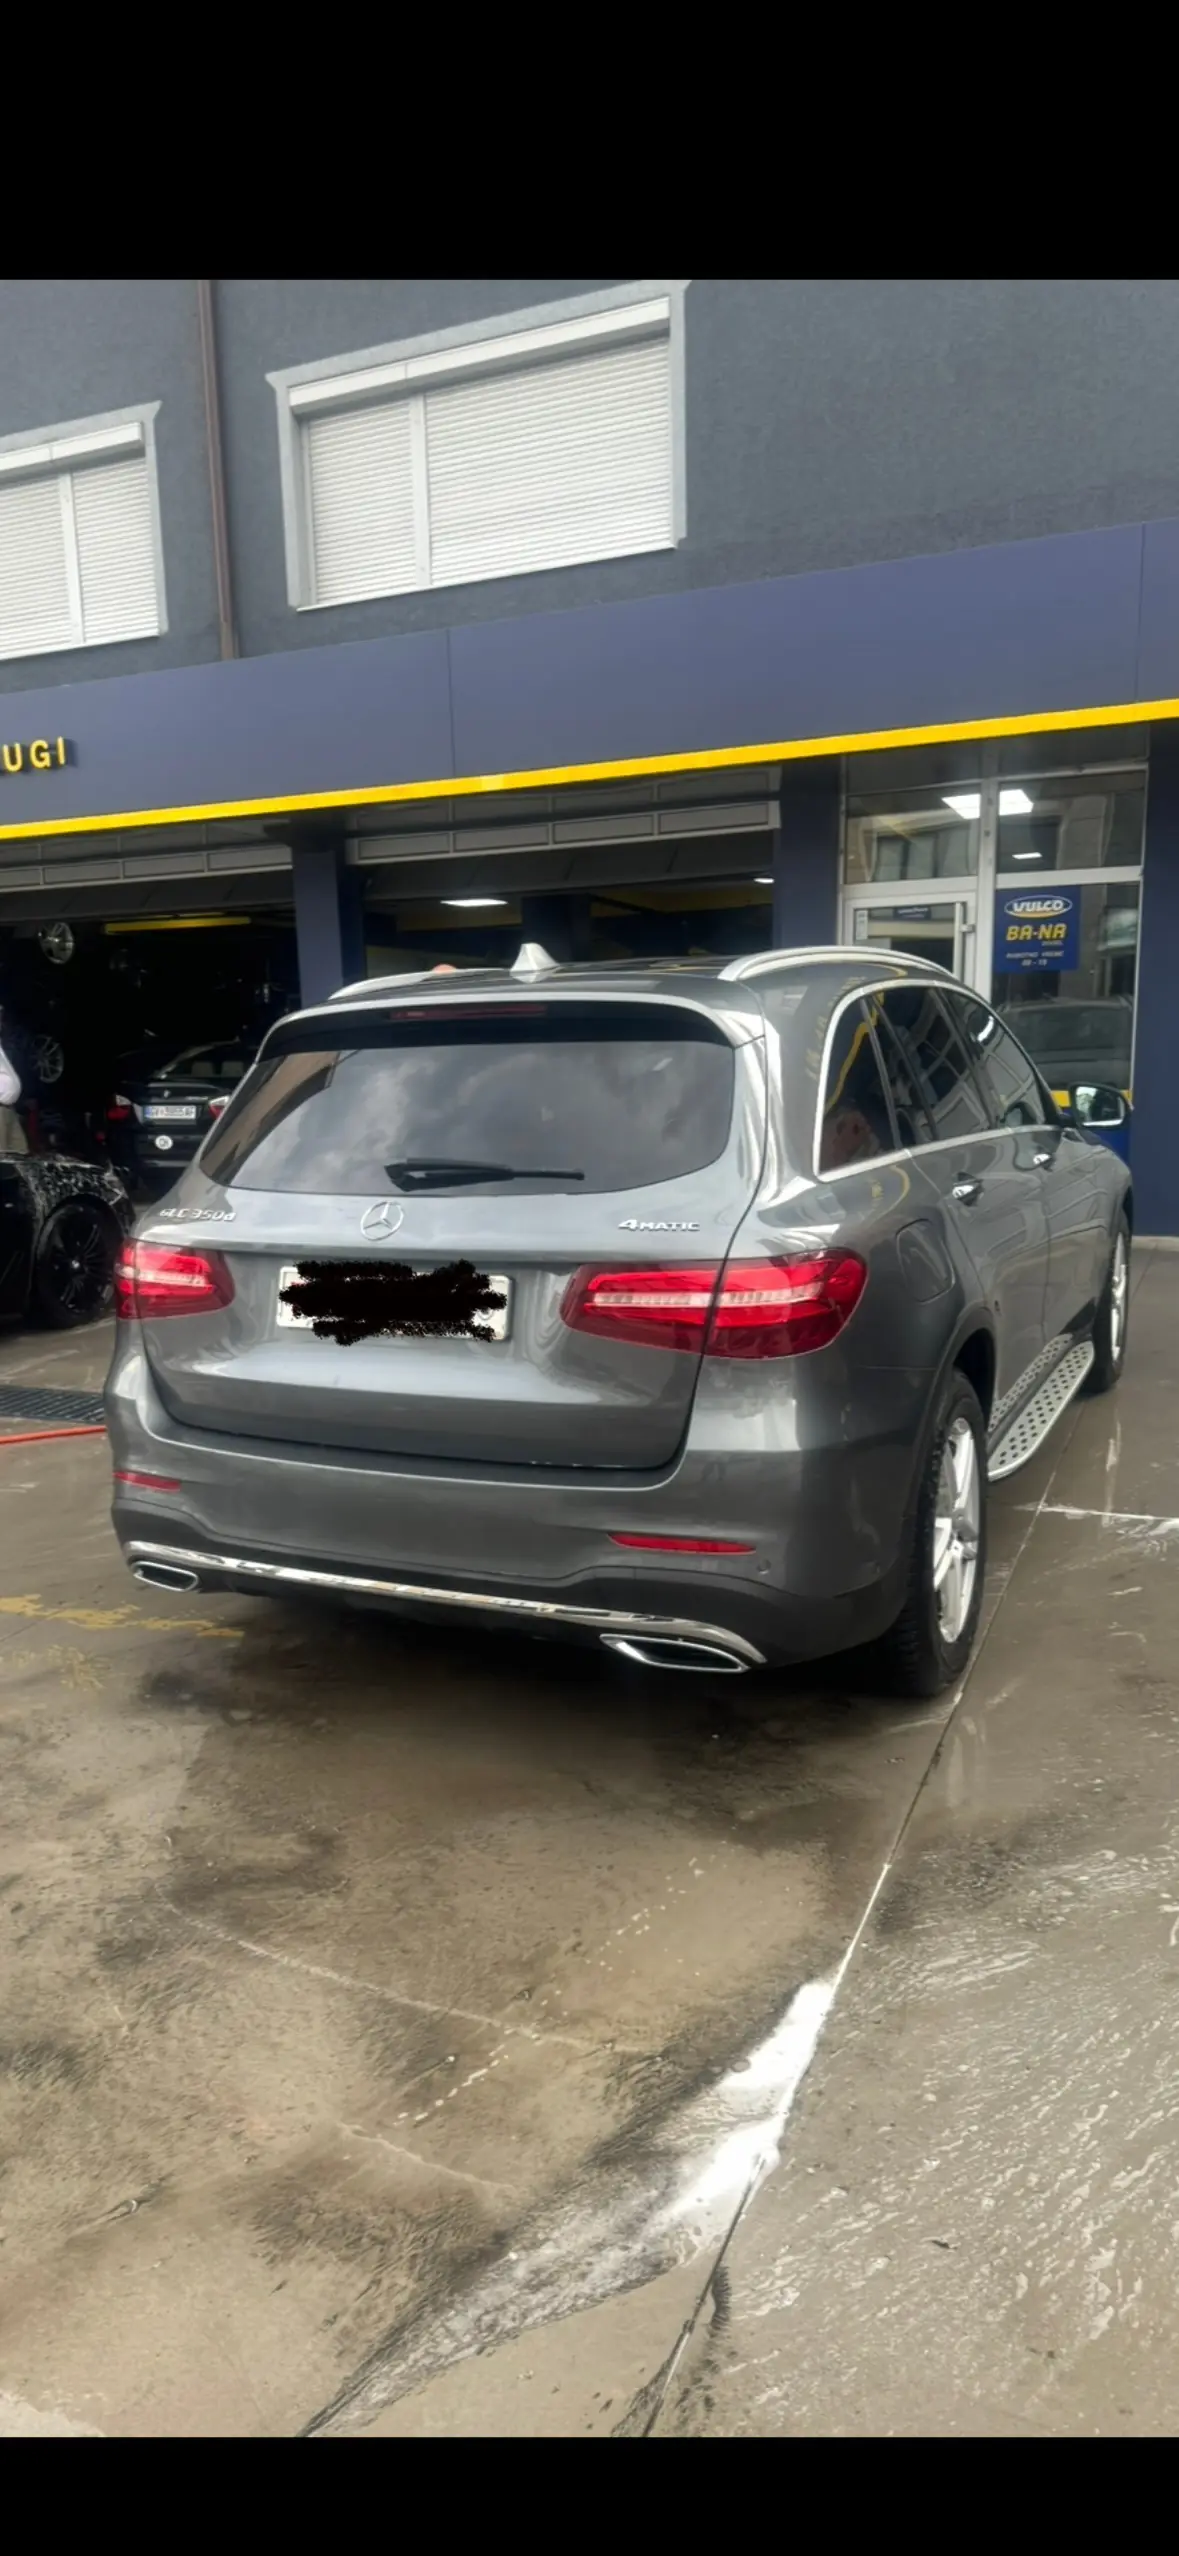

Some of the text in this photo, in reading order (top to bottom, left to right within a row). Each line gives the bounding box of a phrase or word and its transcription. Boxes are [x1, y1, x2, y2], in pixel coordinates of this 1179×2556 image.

[1013, 899, 1063, 912] VULCO
[1006, 923, 1066, 940] BA-NA
[618, 1219, 700, 1231] 4MATIC
